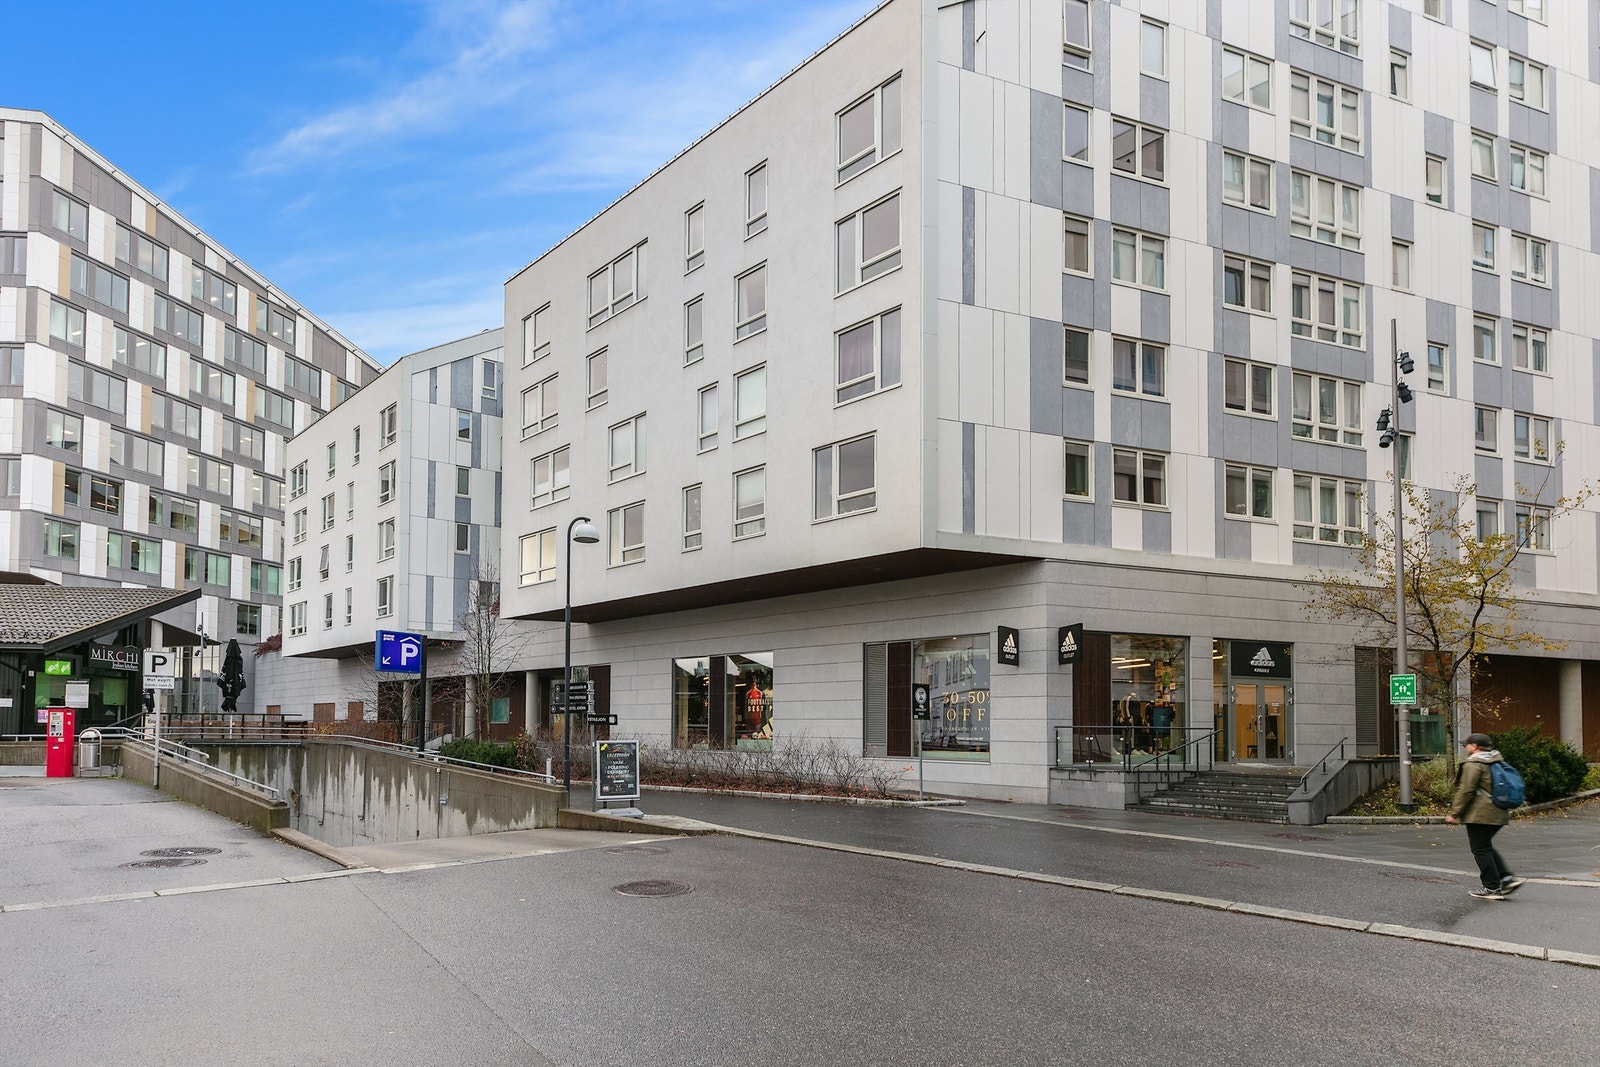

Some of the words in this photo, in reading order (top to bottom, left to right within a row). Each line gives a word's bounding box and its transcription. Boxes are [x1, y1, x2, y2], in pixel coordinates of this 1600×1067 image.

[1003, 645, 1017, 654] adidas
[1061, 643, 1077, 653] adidas
[401, 643, 419, 666] P
[152, 655, 168, 673] P
[1251, 659, 1276, 667] adidas
[947, 708, 986, 721] OFF
